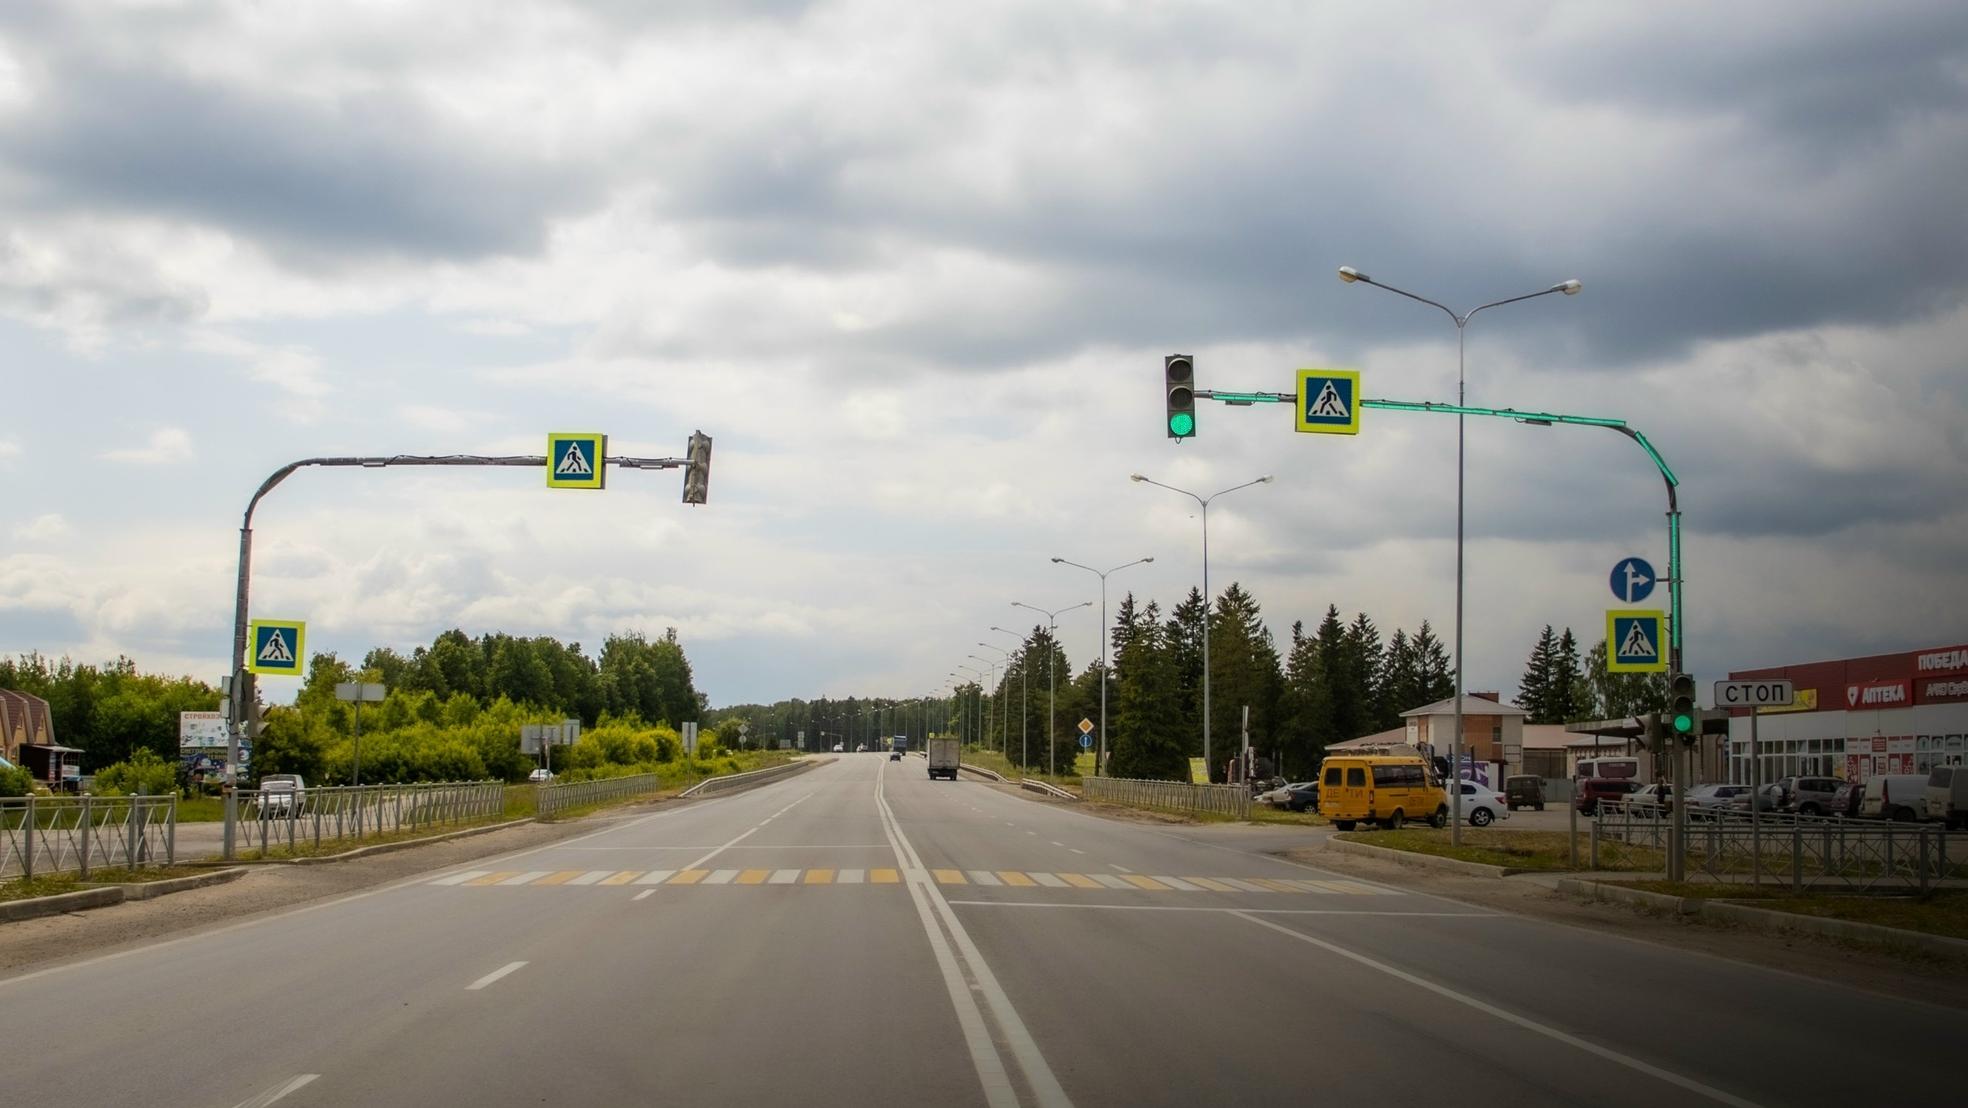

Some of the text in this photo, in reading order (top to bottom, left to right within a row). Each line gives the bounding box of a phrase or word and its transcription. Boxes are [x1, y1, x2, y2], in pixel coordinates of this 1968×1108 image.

[1918, 650, 1968, 671] ПОБЕДА
[1726, 685, 1784, 702] СТОП
[1862, 684, 1905, 704] АПТЕКА
